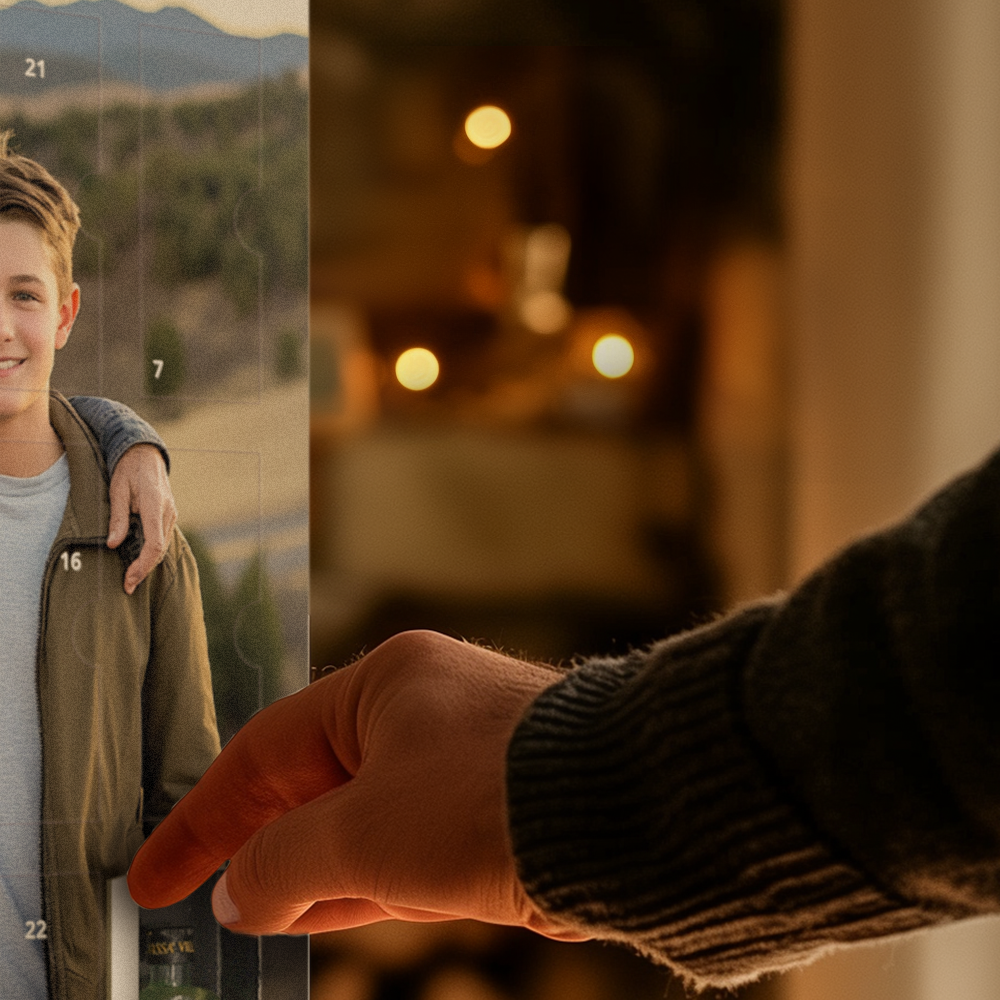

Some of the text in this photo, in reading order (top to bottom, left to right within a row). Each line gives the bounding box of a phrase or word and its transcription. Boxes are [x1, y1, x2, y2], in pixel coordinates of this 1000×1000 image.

[24, 57, 46, 79] 21
[152, 359, 164, 379] 7
[60, 550, 82, 572] 16
[24, 919, 47, 940] 22
